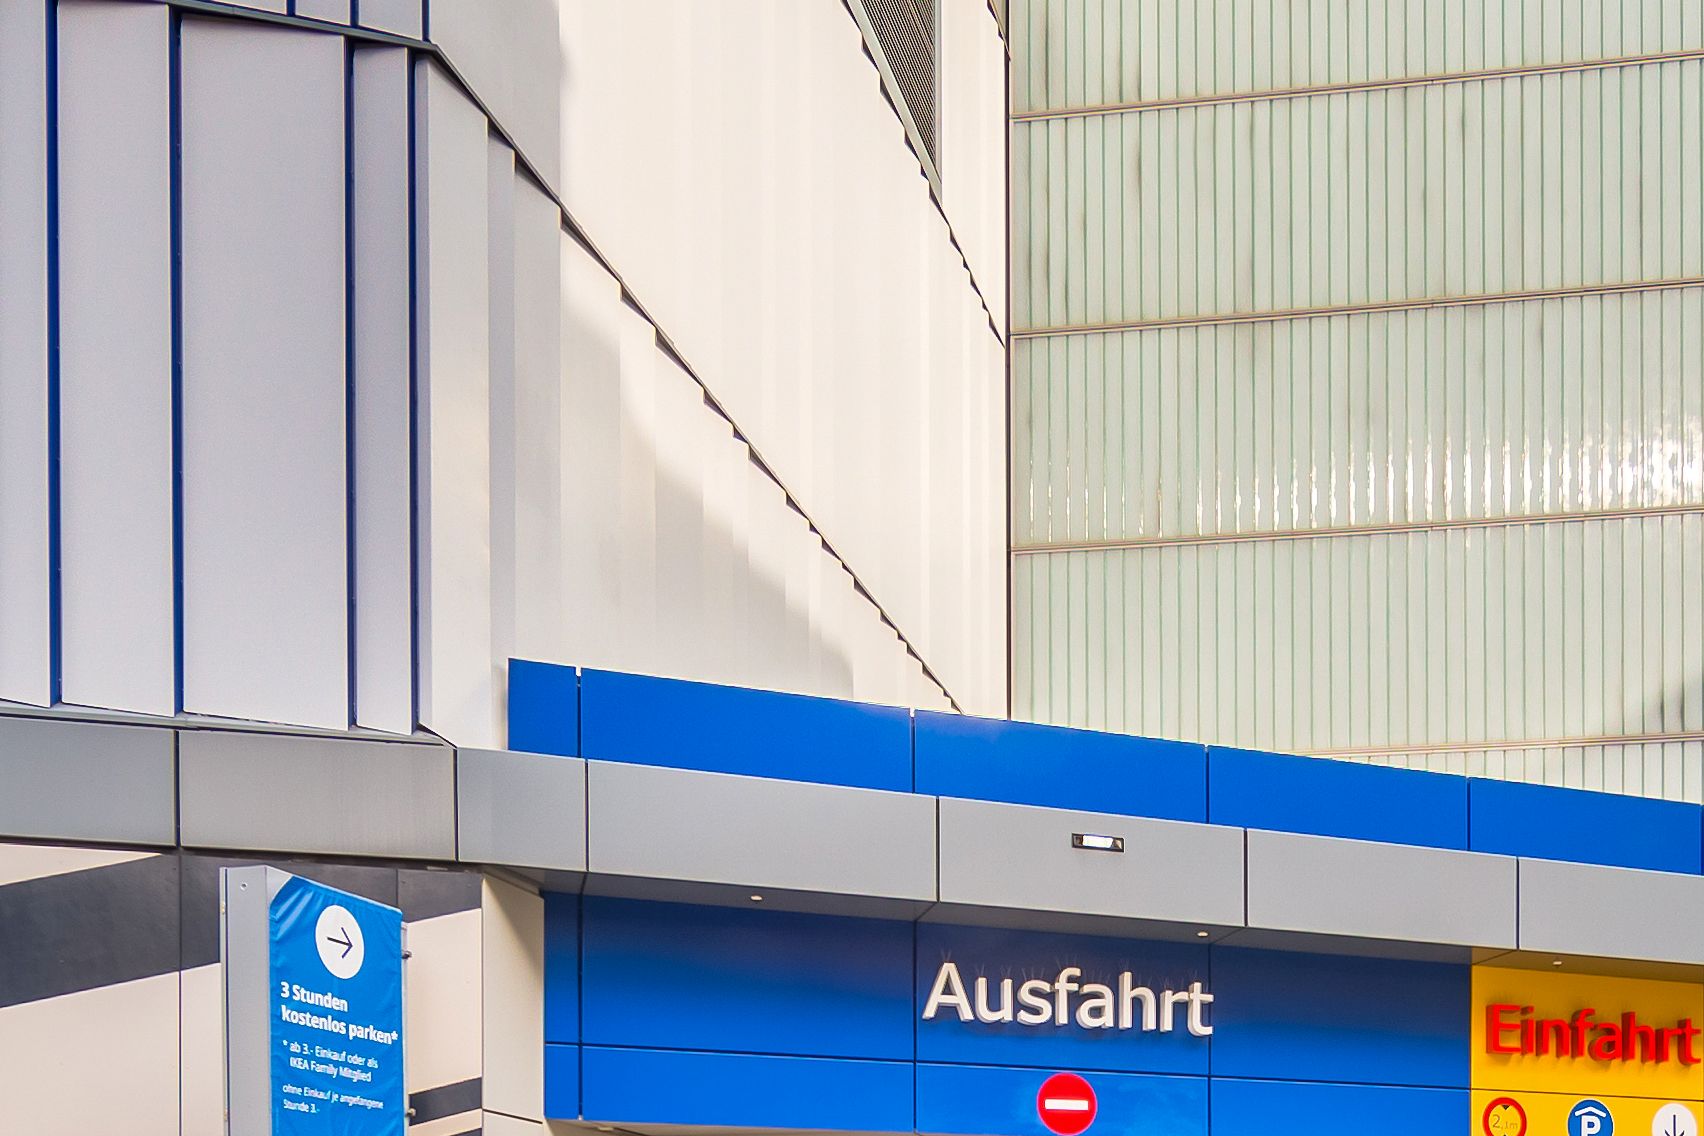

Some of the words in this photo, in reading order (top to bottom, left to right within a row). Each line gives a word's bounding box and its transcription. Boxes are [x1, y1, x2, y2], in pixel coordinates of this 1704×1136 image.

[280, 981, 290, 998] 3
[292, 984, 348, 1012] Stunden
[921, 961, 1215, 1038] Ausfahrt
[281, 1004, 347, 1035] kostenlos
[1486, 1003, 1702, 1066] Einfahrt
[289, 1056, 309, 1070] IKEA
[310, 1060, 338, 1078] Family
[315, 1045, 346, 1062] Einkauf
